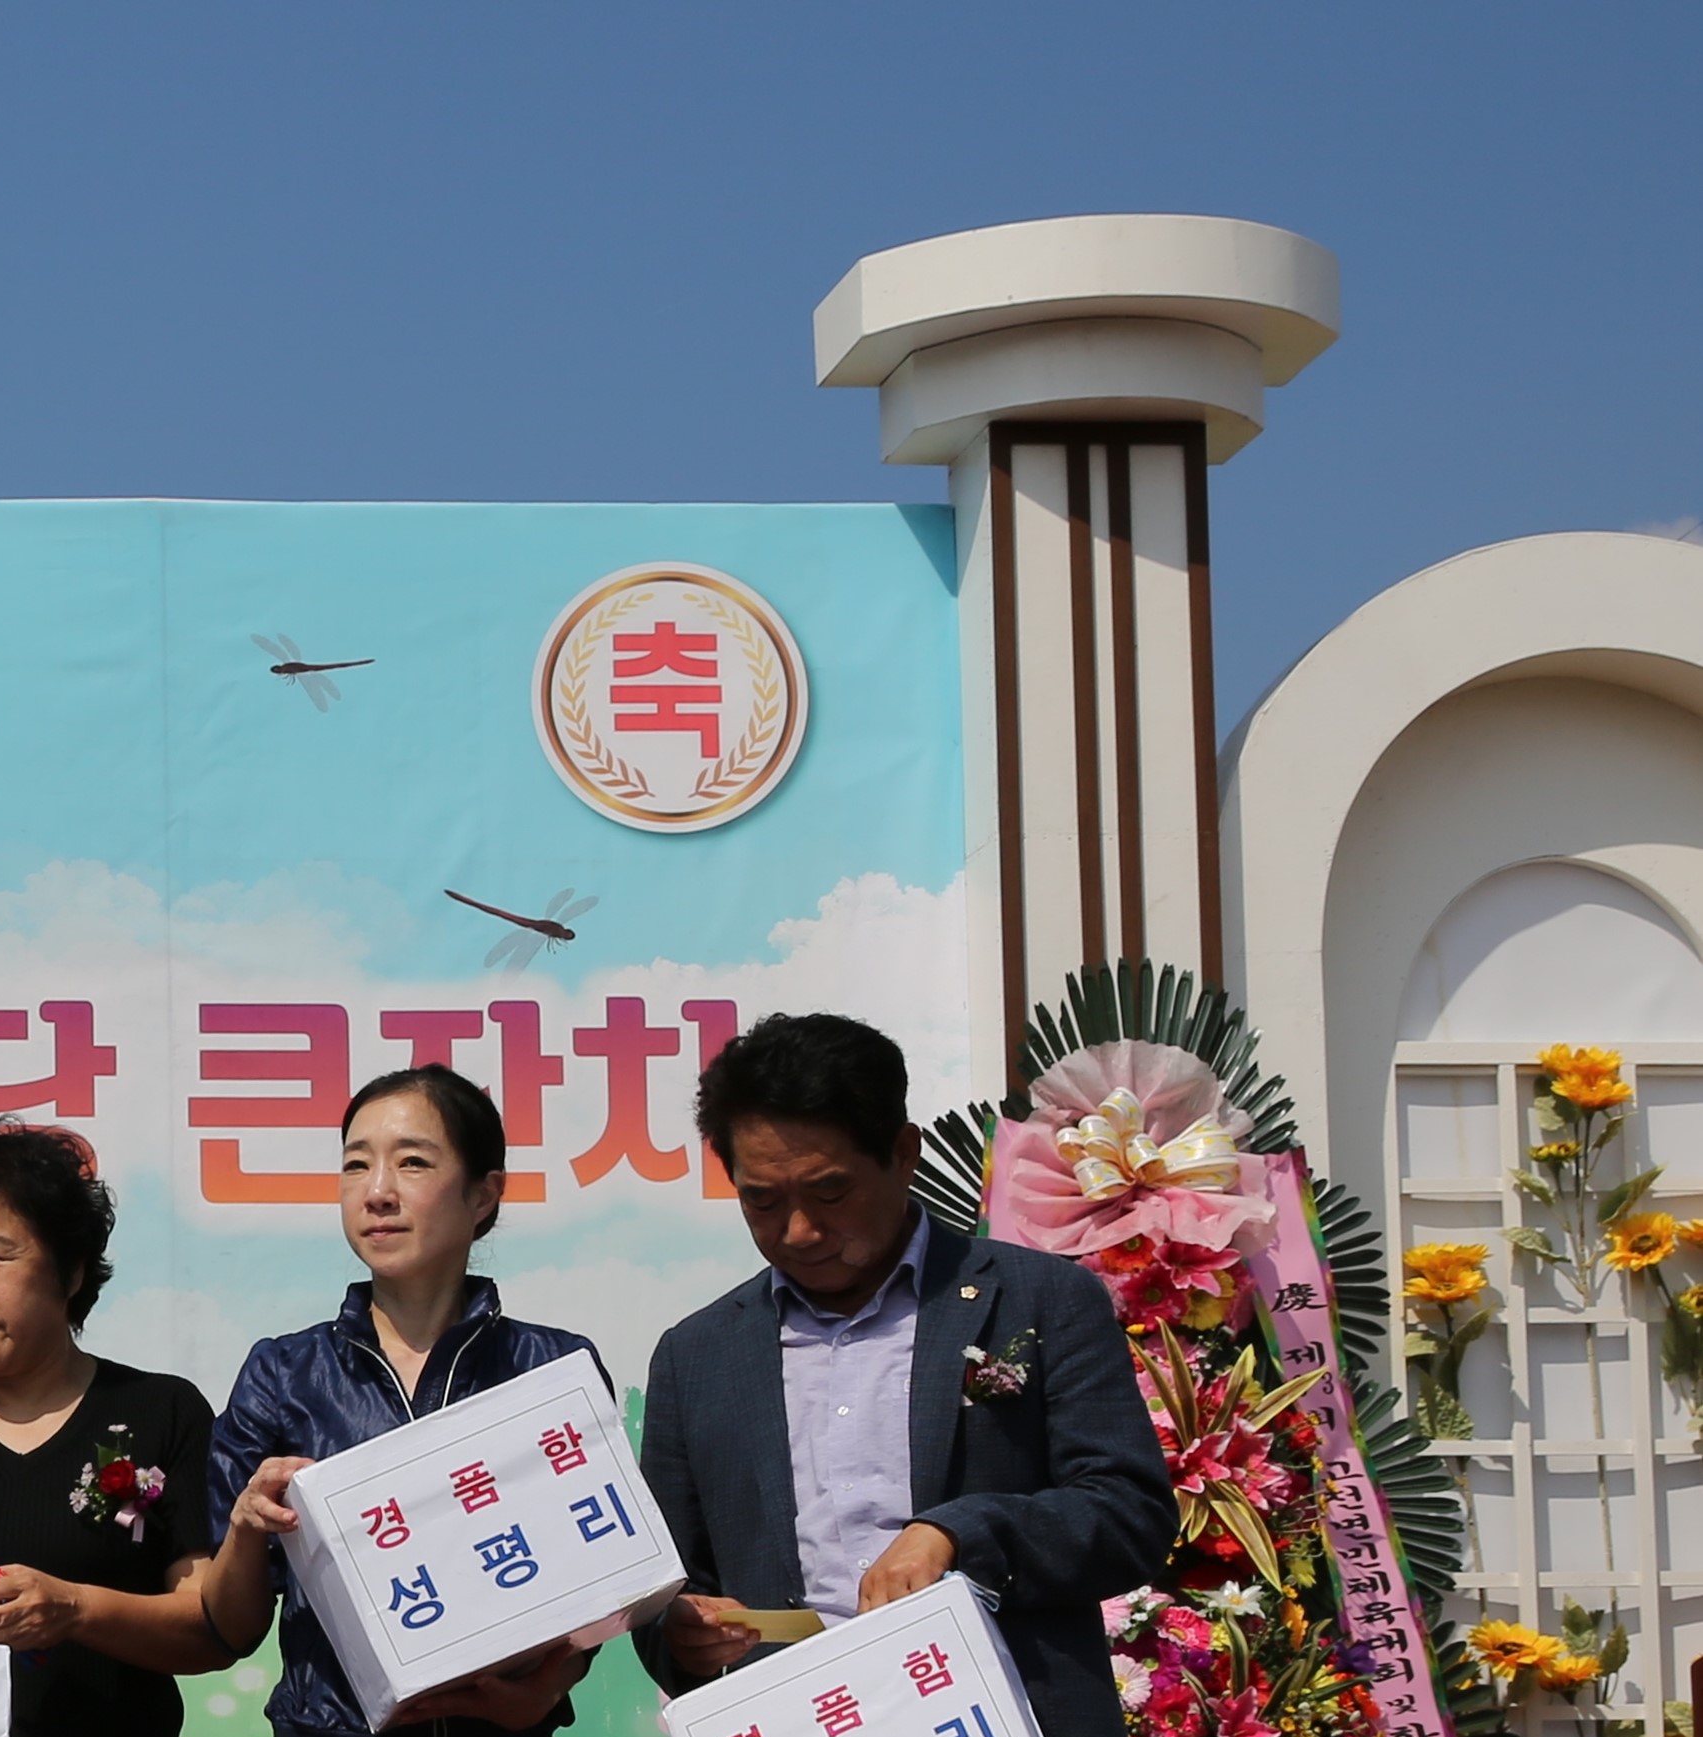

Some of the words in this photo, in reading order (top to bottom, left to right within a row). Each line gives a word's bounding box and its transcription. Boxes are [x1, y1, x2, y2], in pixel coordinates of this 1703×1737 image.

[611, 621, 720, 758] 축
[188, 997, 740, 1203] 큰잔치
[1387, 1695, 1417, 1715] 및
